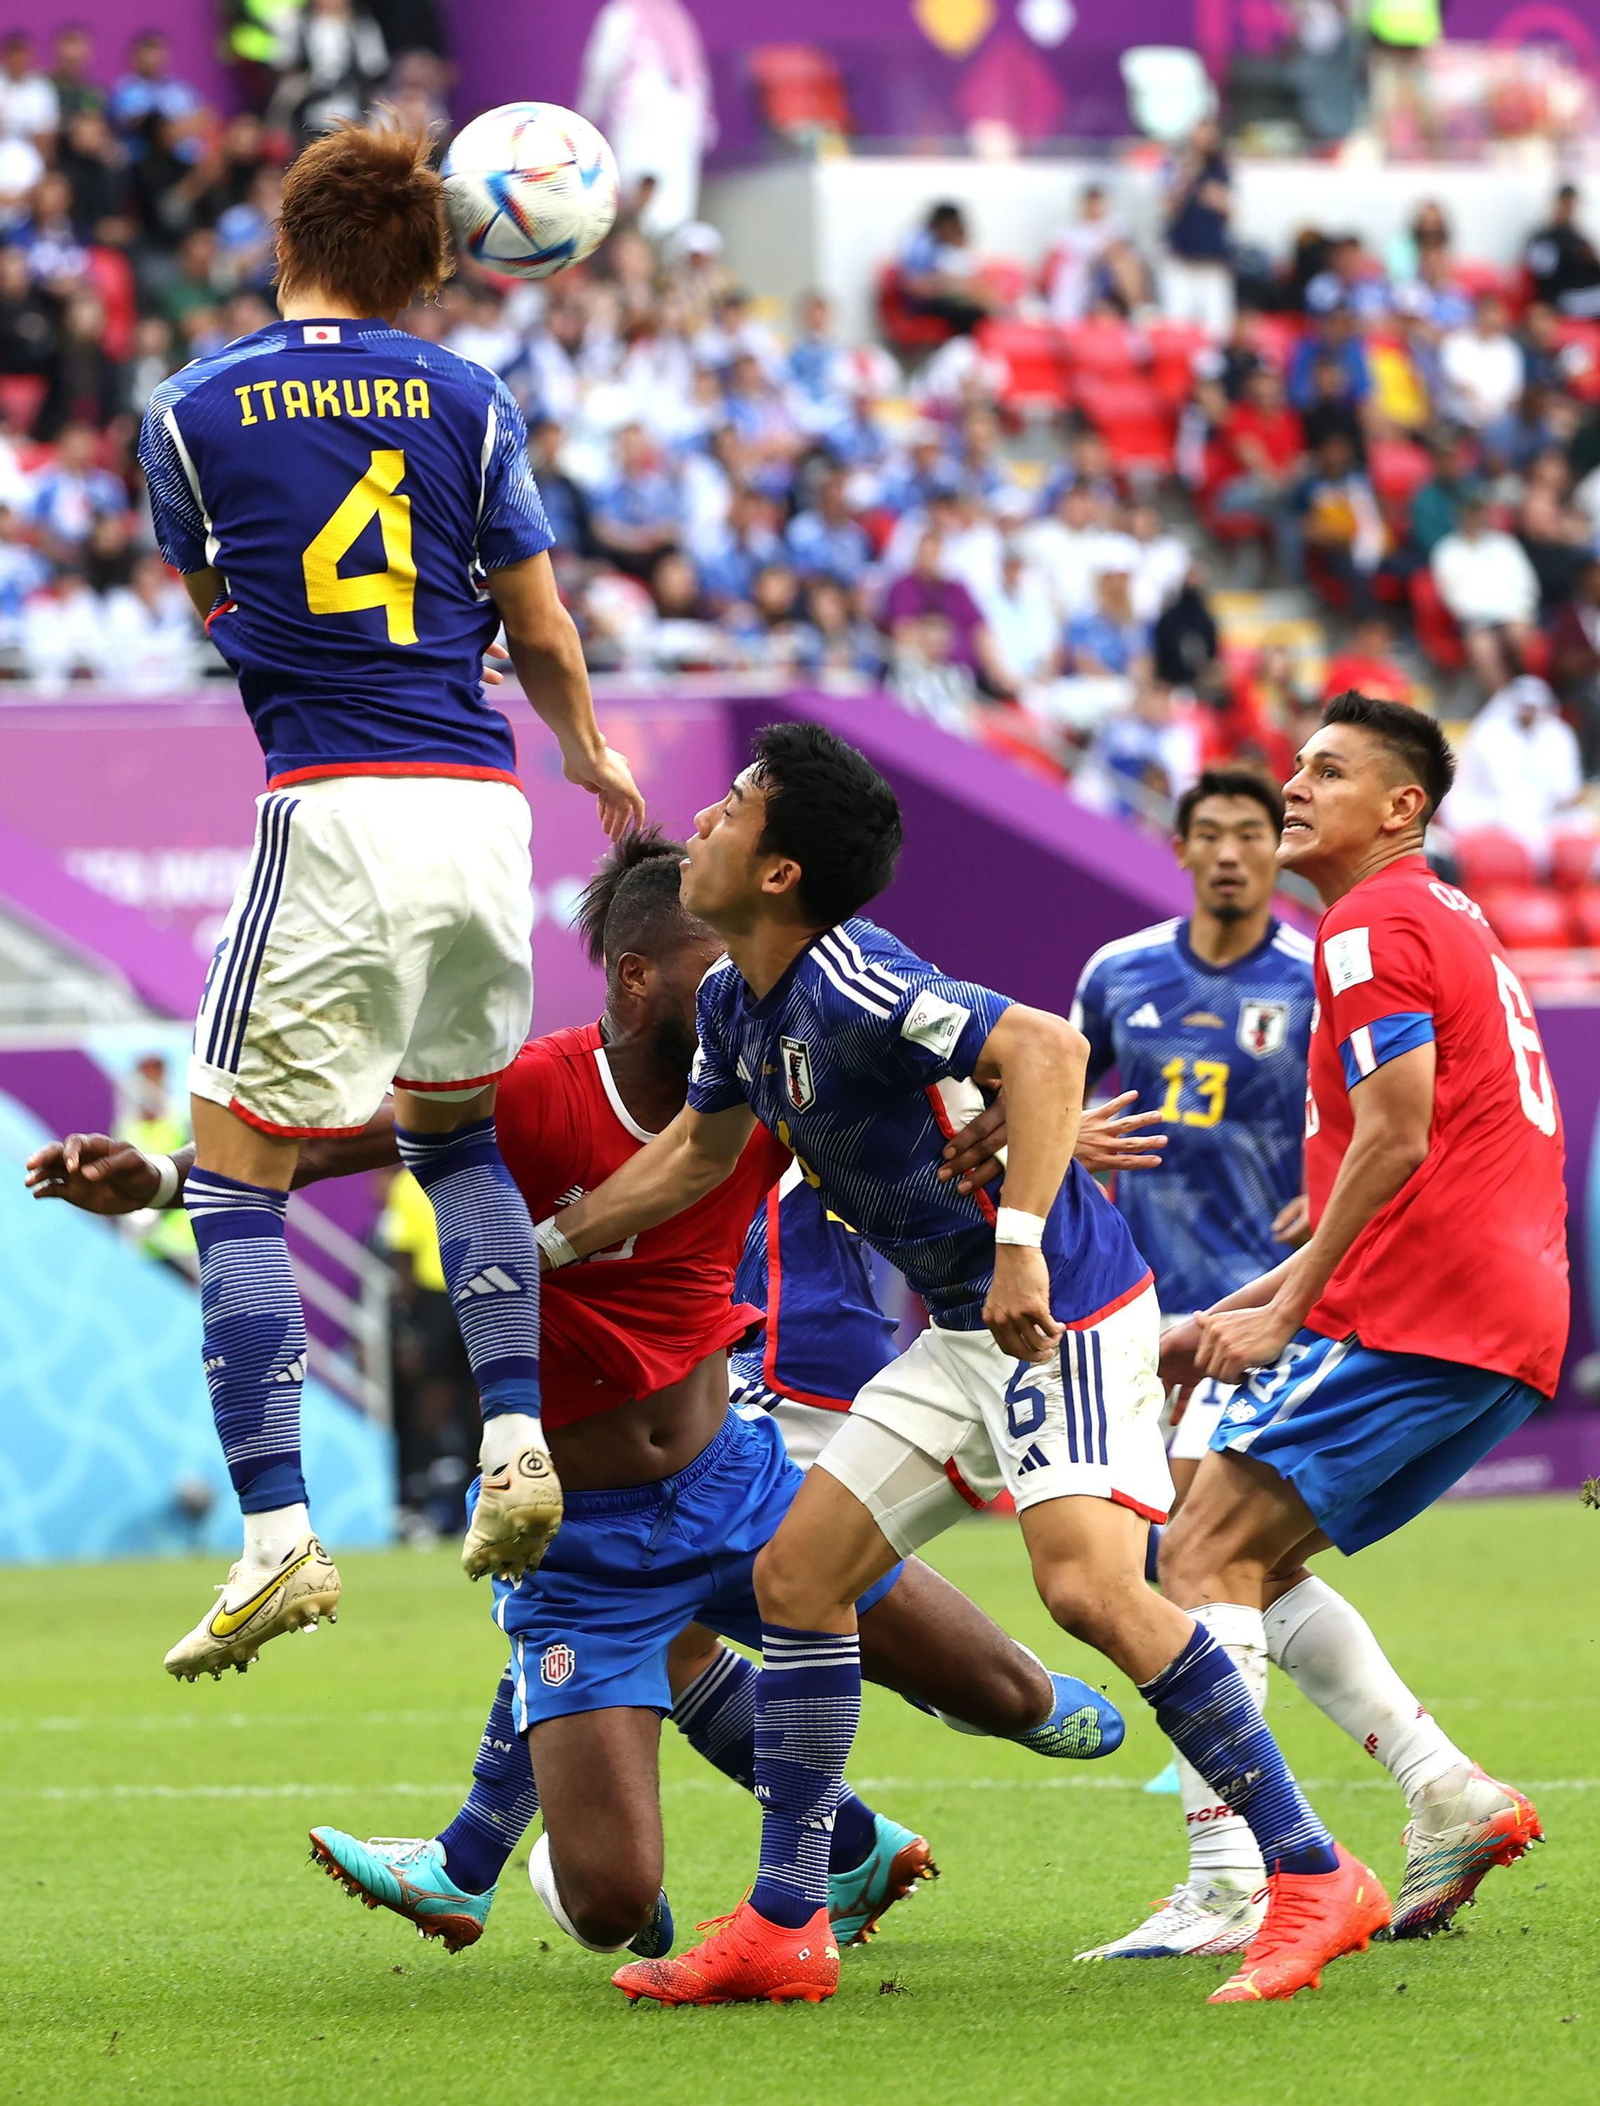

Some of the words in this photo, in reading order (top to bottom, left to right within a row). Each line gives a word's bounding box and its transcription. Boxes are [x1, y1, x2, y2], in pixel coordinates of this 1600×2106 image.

[234, 379, 430, 427] ITAKURA
[302, 449, 418, 646] 4
[1490, 953, 1557, 1138] 6
[1160, 1056, 1230, 1128] 13
[1005, 1359, 1046, 1440] 6
[548, 1652, 566, 1679] CR
[1186, 1804, 1237, 1826] FCR
